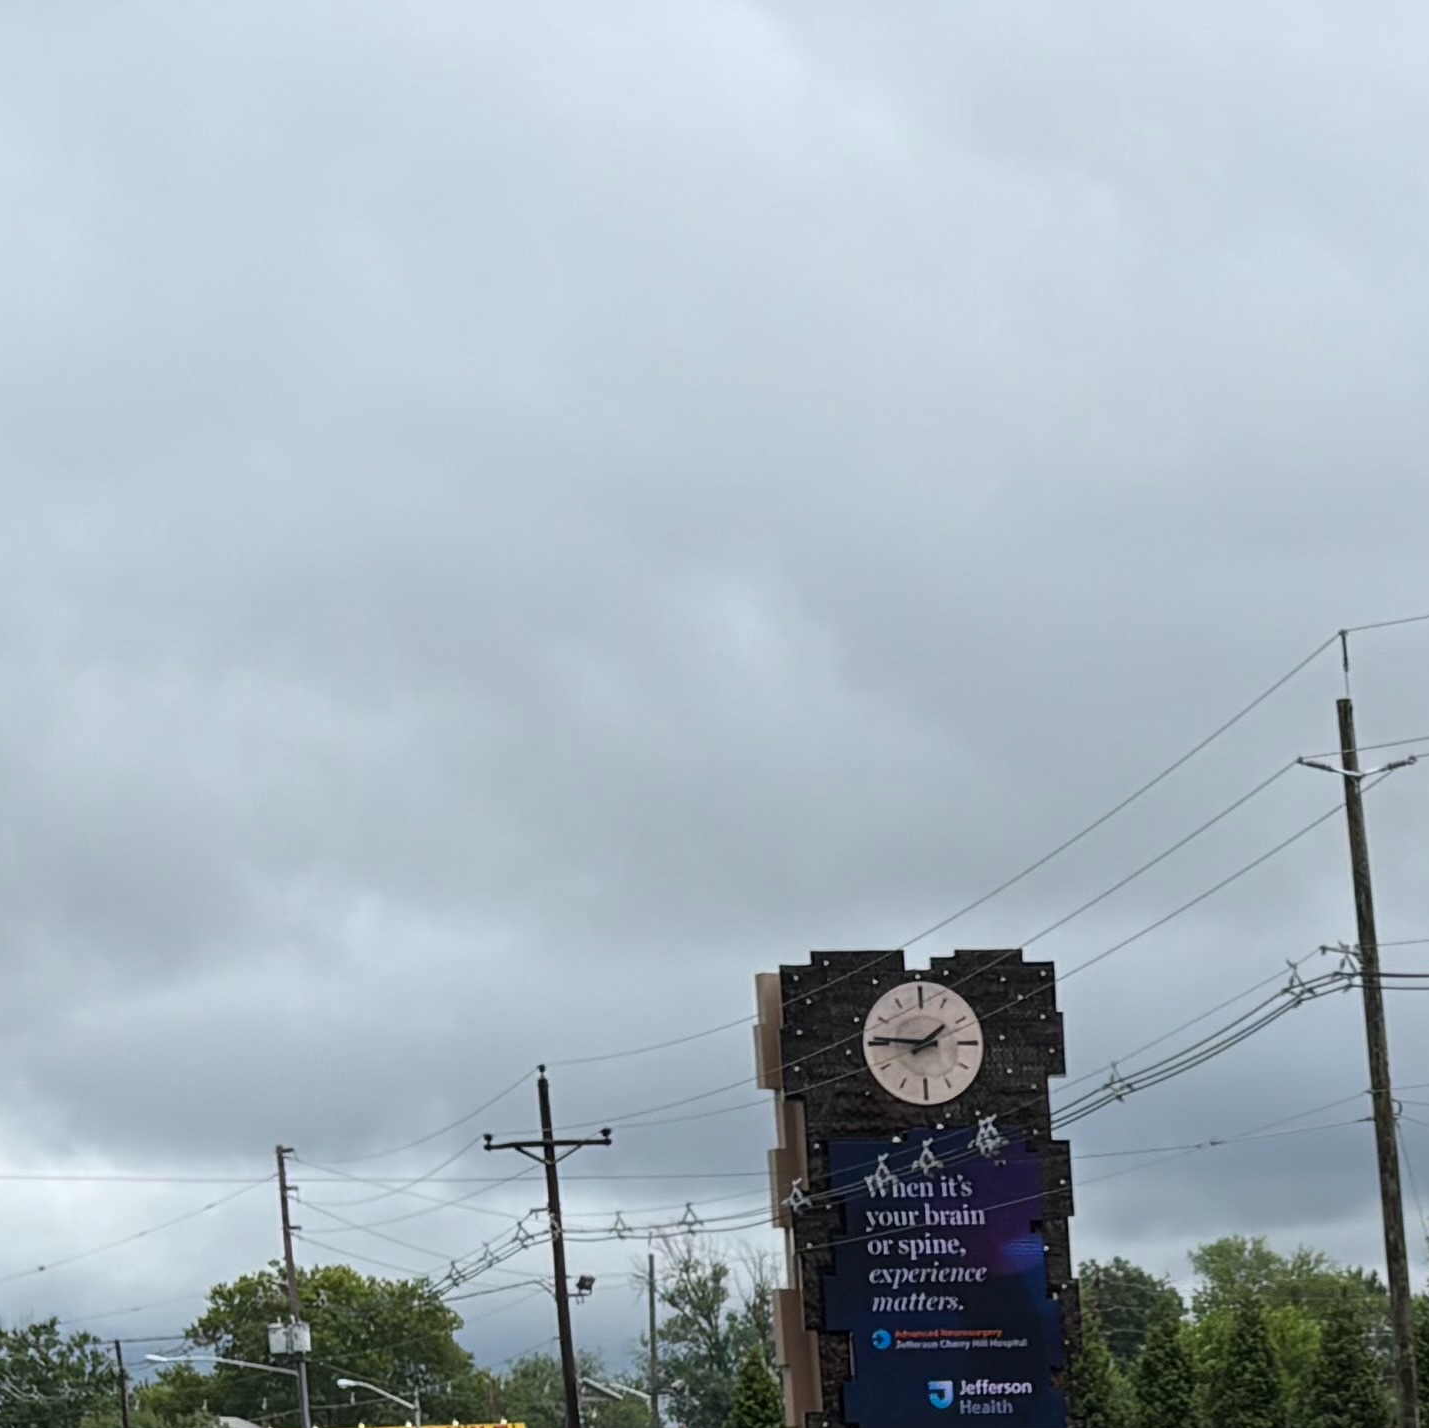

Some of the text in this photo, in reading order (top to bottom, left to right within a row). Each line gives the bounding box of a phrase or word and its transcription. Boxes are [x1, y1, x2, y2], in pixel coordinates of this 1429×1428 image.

[865, 1174, 973, 1198] When it's
[865, 1203, 986, 1232] your brain
[867, 1232, 967, 1261] or spine,
[868, 1261, 987, 1289] experience
[871, 1292, 964, 1312] matters.
[959, 1379, 1033, 1396] Jefferson
[959, 1399, 1013, 1415] Health
